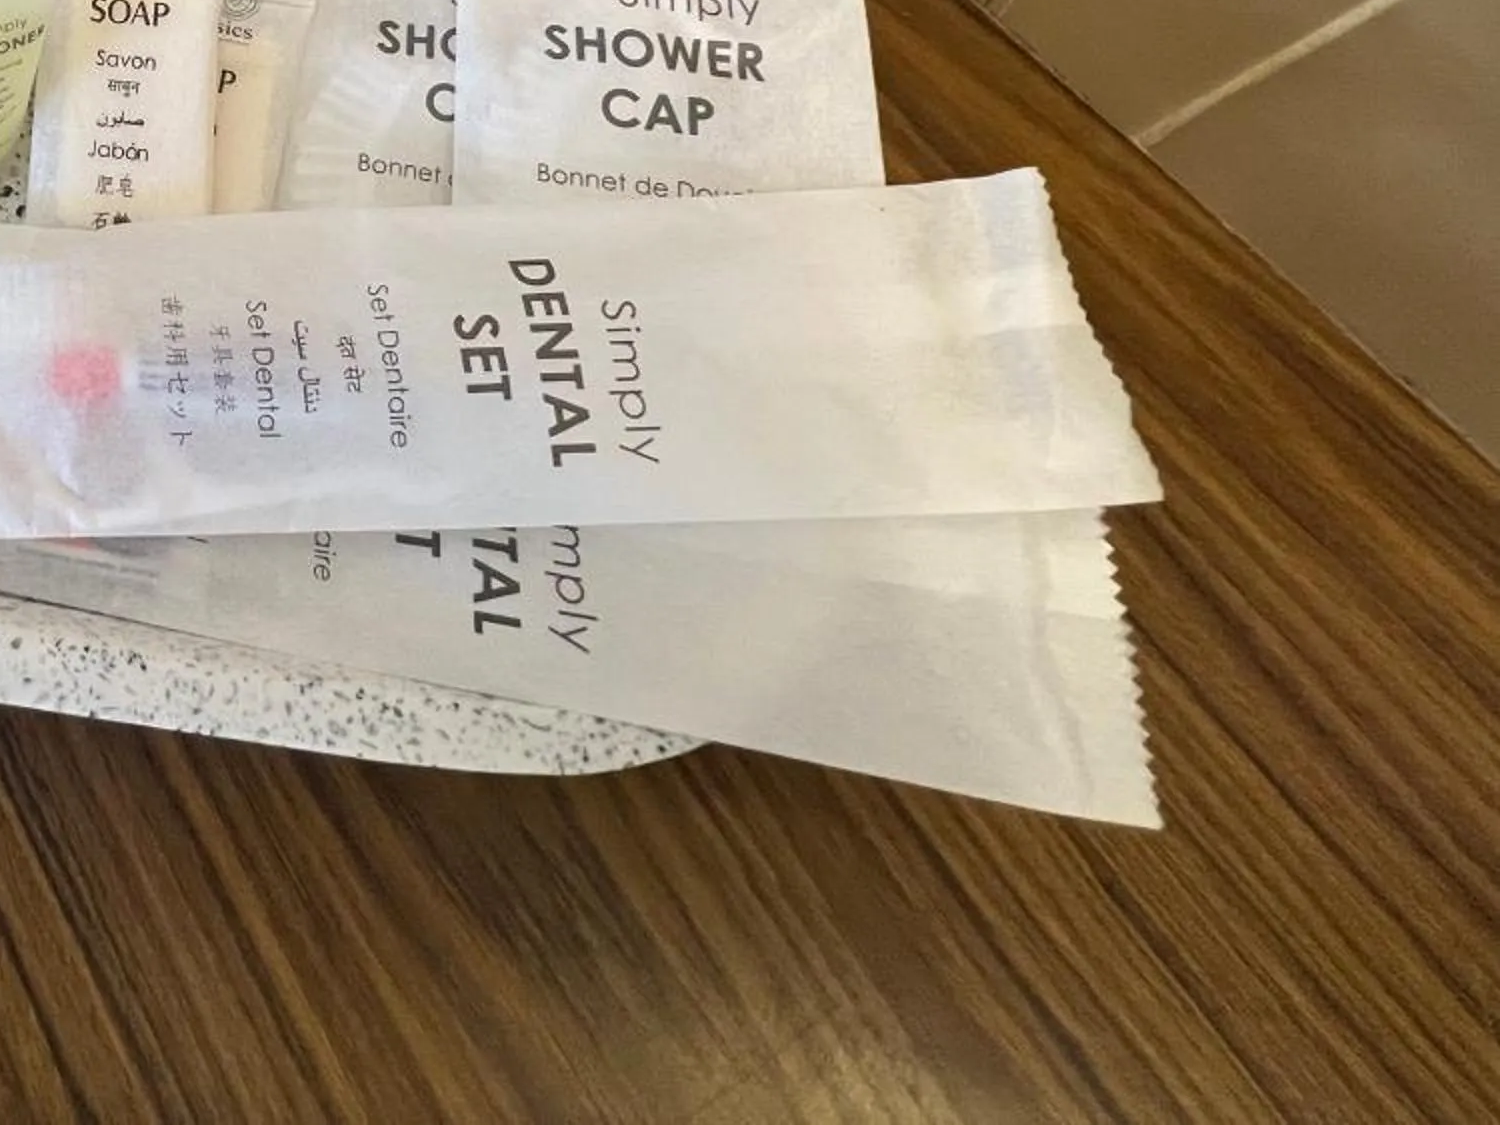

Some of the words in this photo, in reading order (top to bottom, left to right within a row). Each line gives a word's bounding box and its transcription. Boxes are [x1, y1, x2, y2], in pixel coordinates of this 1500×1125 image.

[95, 48, 157, 71] Savon
[543, 24, 765, 82] SHOWER
[601, 87, 715, 137] CAP
[87, 139, 150, 163] Jabón
[357, 152, 441, 184] Bonnet
[537, 162, 626, 192] Bonnet
[635, 177, 669, 198] de
[245, 300, 272, 339] Set
[367, 283, 395, 321] Set
[453, 314, 512, 401] SET
[508, 258, 597, 468] DENTAL
[600, 298, 662, 464] Simply
[251, 347, 284, 440] Dental
[377, 330, 413, 449] Dentaire
